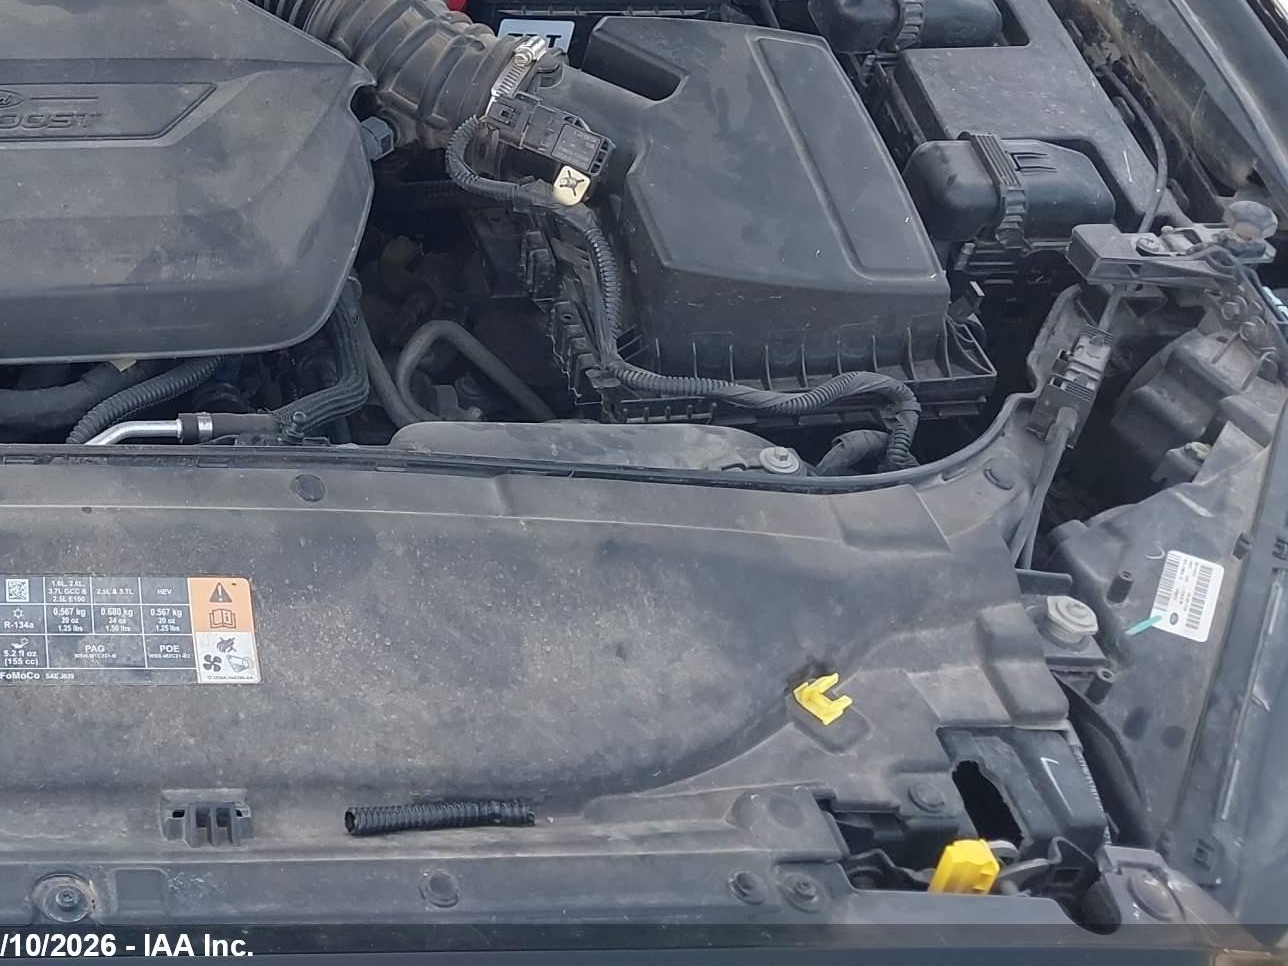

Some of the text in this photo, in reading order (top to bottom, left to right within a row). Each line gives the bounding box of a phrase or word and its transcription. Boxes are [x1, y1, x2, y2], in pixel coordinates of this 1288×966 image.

[52, 607, 86, 618] 0.567 kg
[122, 608, 134, 618] kg
[150, 608, 182, 618] 0.567 kg
[3, 621, 35, 629] R-134a
[84, 644, 106, 653] PAG
[159, 644, 180, 653] POE
[3, 650, 17, 658] 5.2
[4, 658, 39, 667] (155 cc)
[0, 672, 41, 680] FoMoCo
